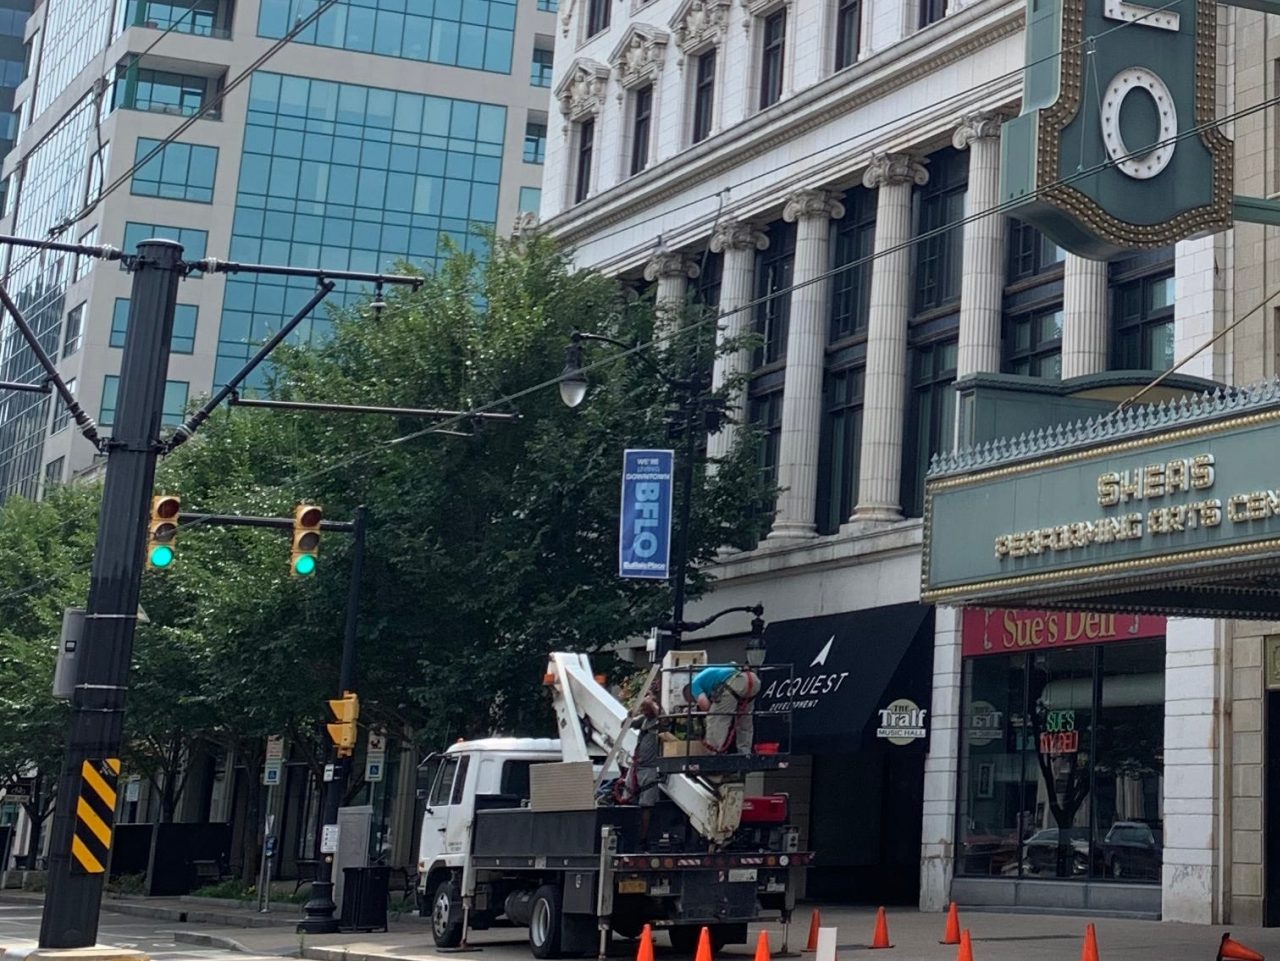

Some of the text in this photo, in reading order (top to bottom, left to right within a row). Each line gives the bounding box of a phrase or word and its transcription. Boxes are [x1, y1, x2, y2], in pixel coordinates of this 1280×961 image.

[625, 472, 671, 480] DOWNTOWN
[632, 482, 660, 558] BFLO
[994, 511, 1143, 559] PERFORMING
[1147, 498, 1222, 534] ARTS
[1003, 609, 1058, 648] Sue's
[762, 672, 849, 699] ACQUEST
[878, 709, 927, 727] Tralf
